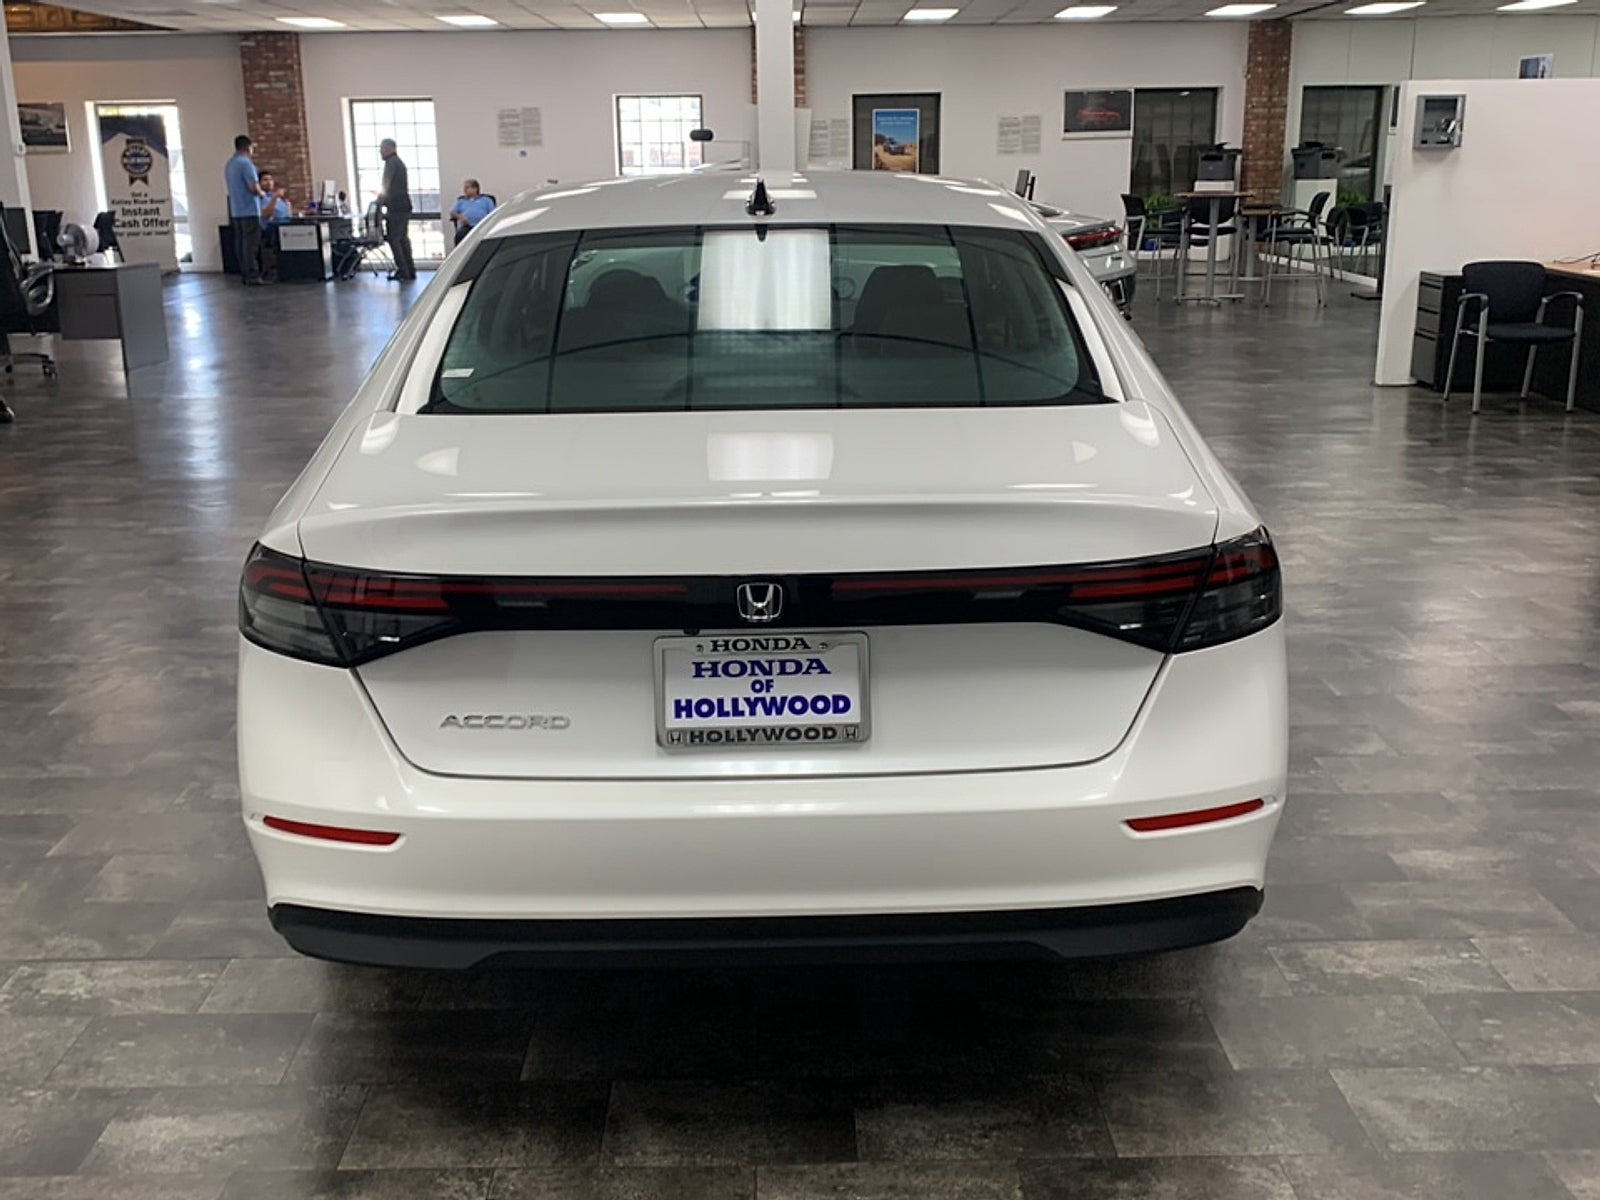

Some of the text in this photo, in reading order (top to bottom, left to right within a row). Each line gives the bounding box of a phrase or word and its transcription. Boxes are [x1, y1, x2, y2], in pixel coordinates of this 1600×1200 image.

[122, 207, 160, 216] Instant
[113, 218, 170, 228] Cash Offer
[710, 637, 811, 652] HONDA
[692, 658, 831, 678] HONDA
[750, 679, 774, 693] OF
[674, 694, 851, 719] HOLLYWOOD
[440, 714, 571, 730] ACCORD
[690, 727, 838, 743] HOLLYWOOD
